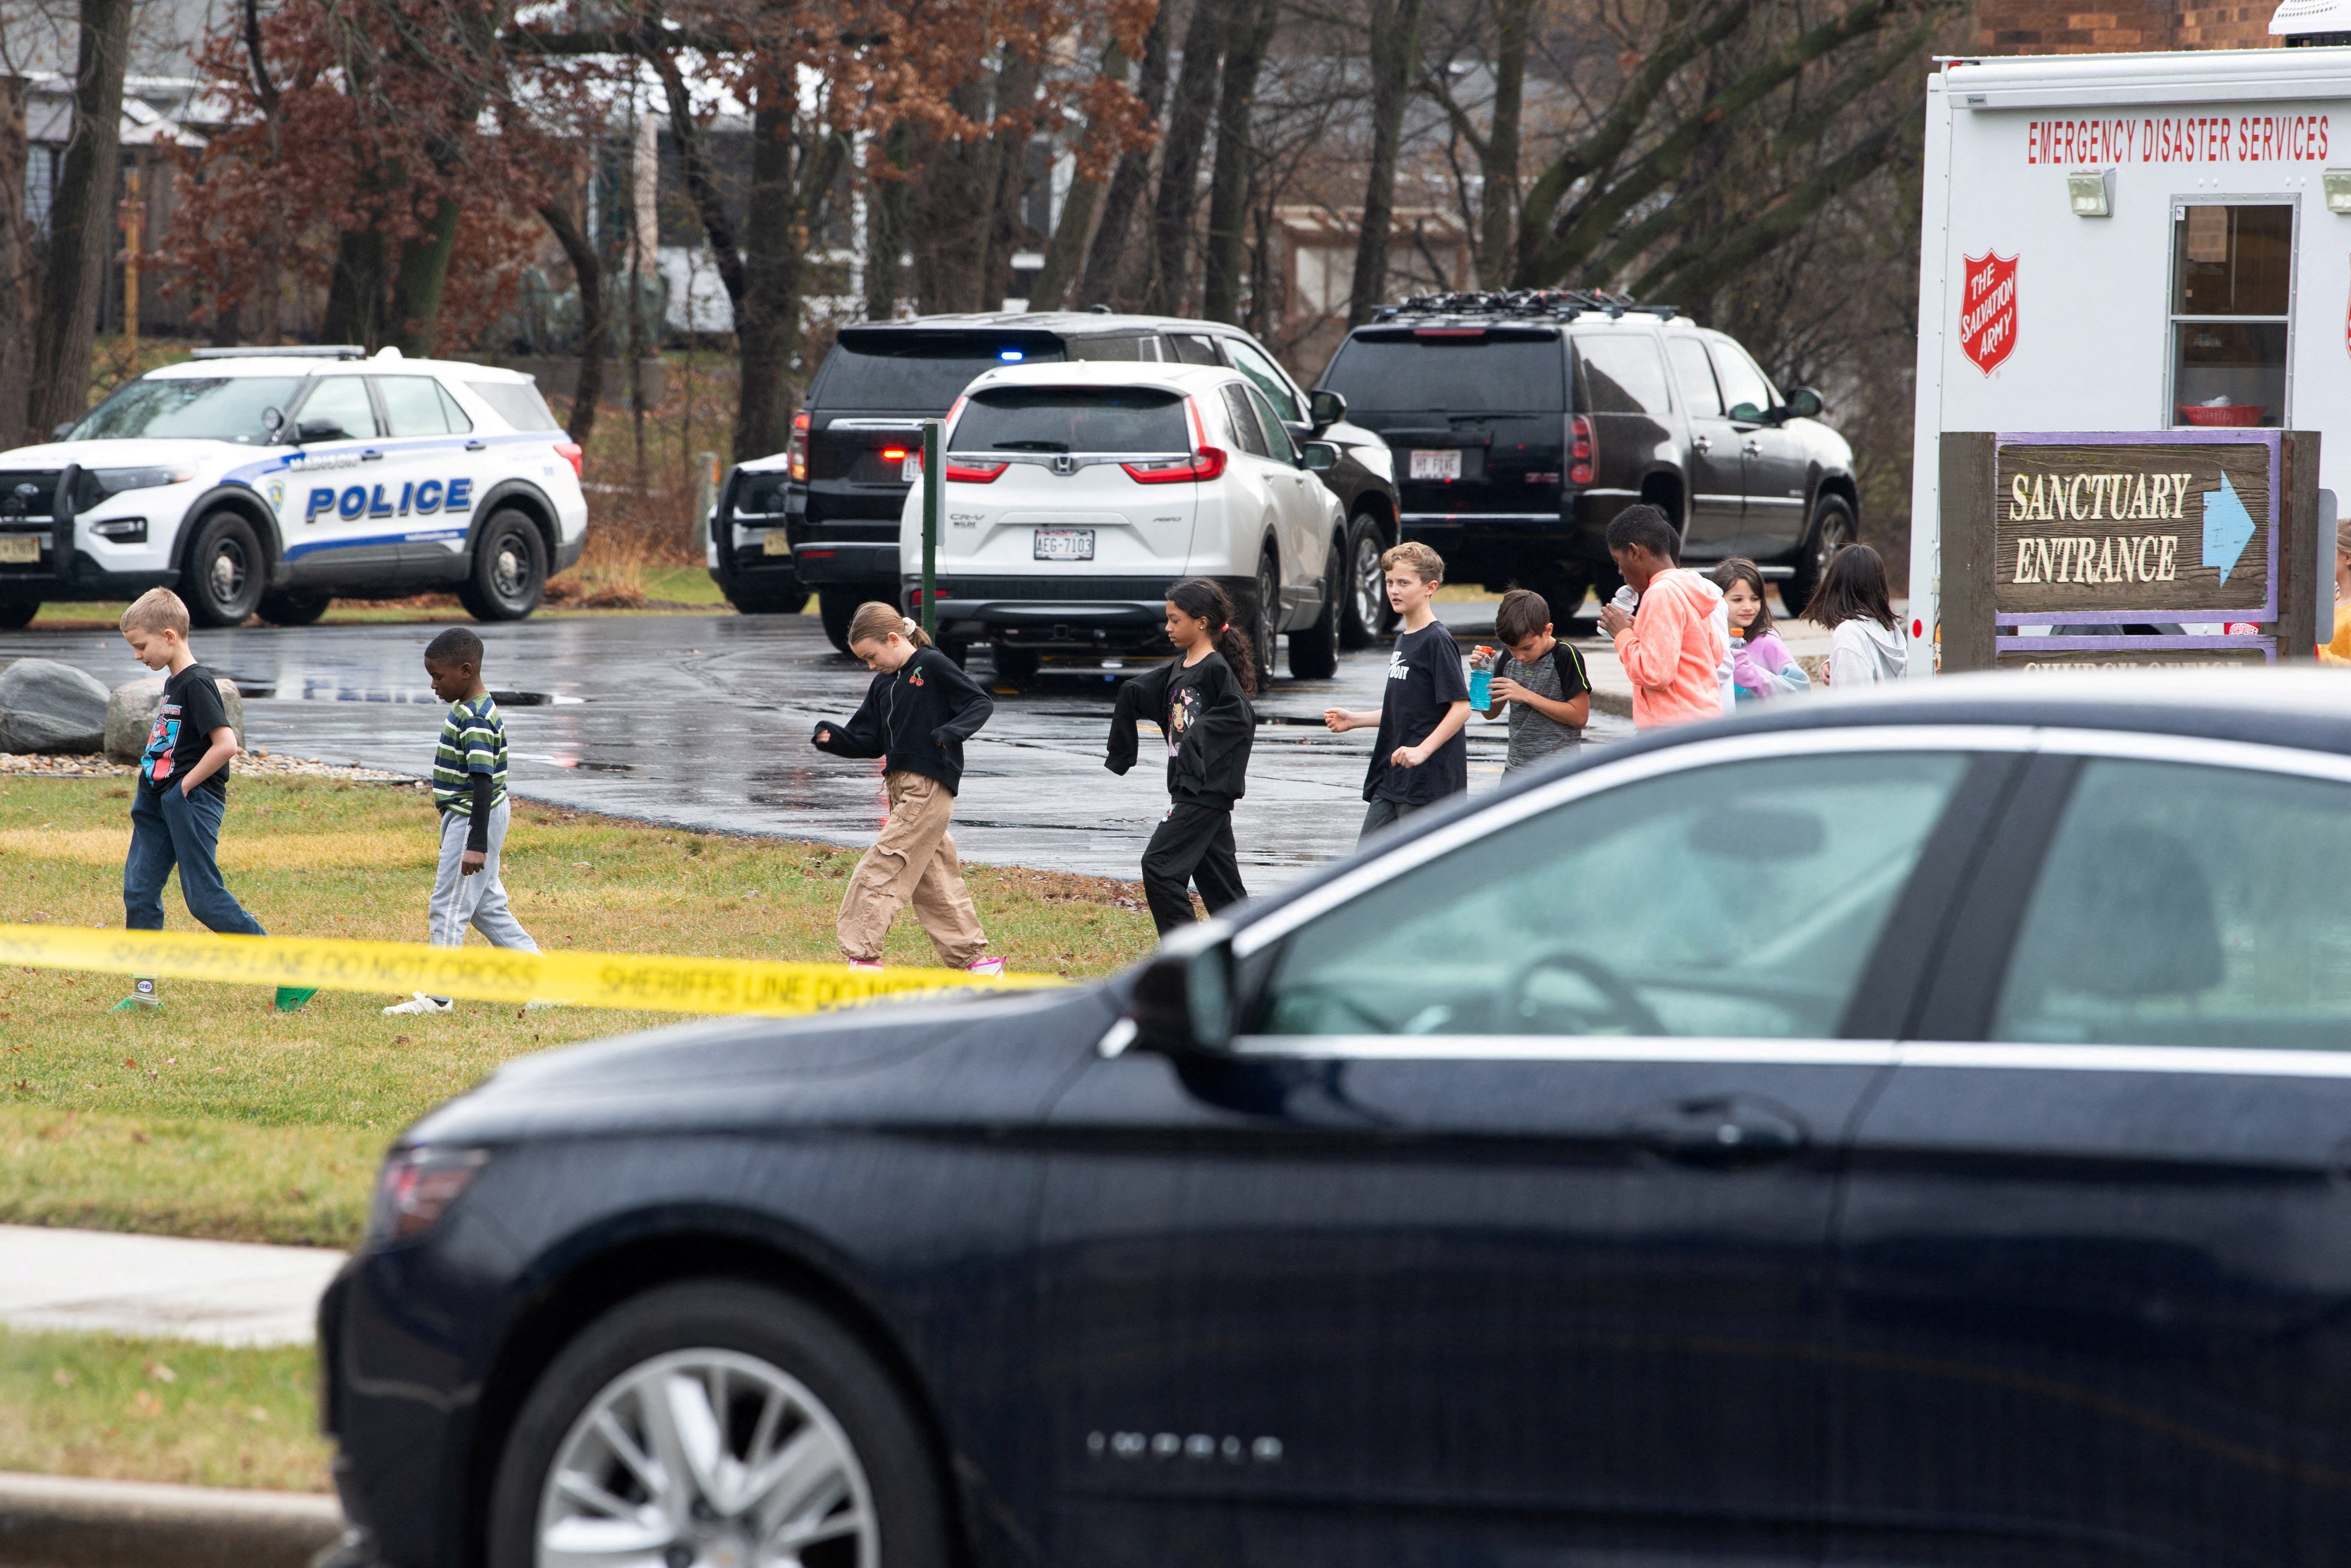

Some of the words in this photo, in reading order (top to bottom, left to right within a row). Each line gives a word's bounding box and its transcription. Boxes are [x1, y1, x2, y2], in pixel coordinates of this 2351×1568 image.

[2028, 119, 2136, 164] EMERGENCY
[2143, 118, 2230, 162] DISASTER
[2238, 115, 2329, 161] SERVICES
[1971, 262, 1996, 301] THE
[1962, 270, 2014, 343] SALVATION
[1979, 307, 2013, 361] ARMY
[305, 478, 472, 524] POLICE
[2009, 473, 2192, 521] SANCTUARY
[1037, 538, 1092, 553] AEG-7103
[2012, 535, 2178, 584] ENTRANCE
